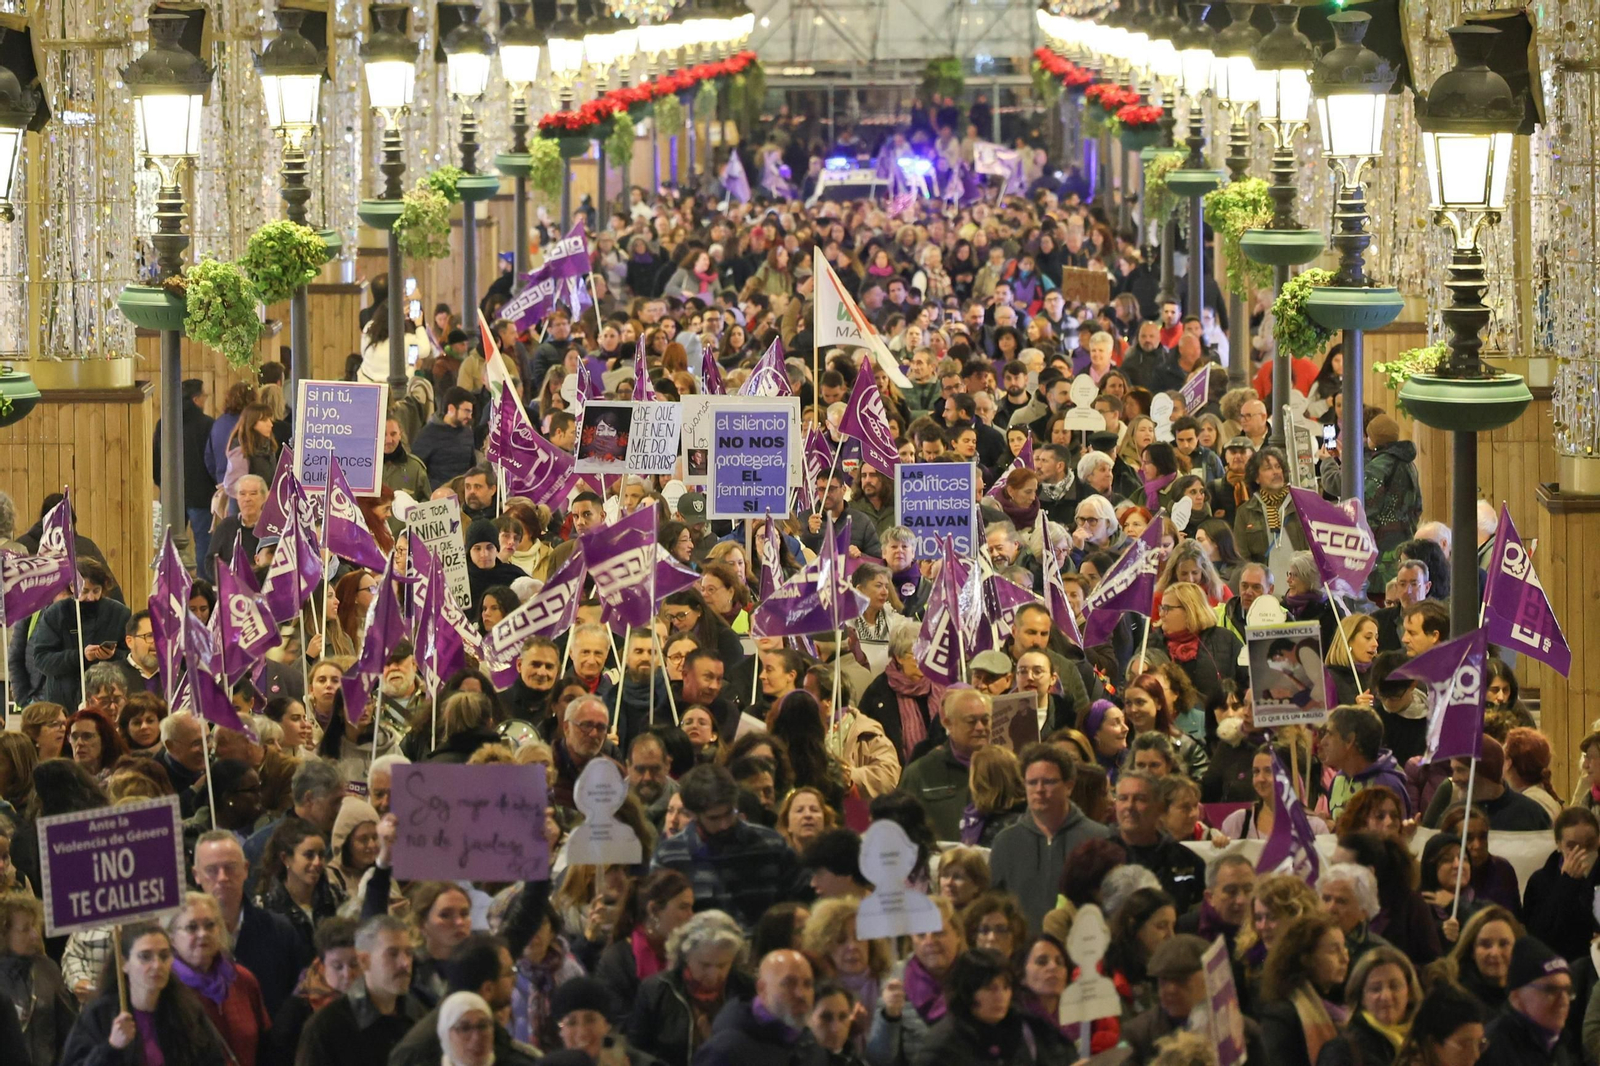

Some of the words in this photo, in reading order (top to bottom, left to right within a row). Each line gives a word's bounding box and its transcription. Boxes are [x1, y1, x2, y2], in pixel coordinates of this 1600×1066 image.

[307, 387, 319, 401] si
[321, 388, 334, 402] ni
[337, 388, 353, 404] tú,
[306, 403, 319, 418] ni
[321, 407, 340, 420] yo,
[632, 404, 651, 421] ¿DE
[654, 404, 676, 422] QUÉ
[306, 420, 353, 435] hemos
[634, 422, 675, 438] TIENEN
[716, 414, 730, 431] el
[732, 414, 786, 431] silencio
[631, 438, 667, 454] MIEDO
[719, 436, 744, 448] NO
[749, 436, 785, 448] NOS
[303, 453, 373, 467] ¿enonces
[716, 450, 786, 470] protegerá,
[742, 470, 762, 482] EL
[902, 471, 924, 479] LAS
[716, 482, 785, 499] feminismo
[902, 474, 970, 497] políticas
[409, 509, 426, 522] QUE
[430, 504, 449, 517] TODA
[902, 495, 971, 514] feministas
[904, 515, 969, 527] SALVAN
[440, 541, 454, 552] QUE
[1302, 711, 1325, 719] ABUSO
[88, 820, 116, 833] Ante
[118, 816, 130, 827] la
[52, 837, 108, 855] Violencia
[109, 834, 125, 845] de
[126, 826, 169, 843] Género
[92, 847, 135, 883] ¡NO
[68, 890, 92, 918] TE
[94, 877, 166, 913] CALLES!
